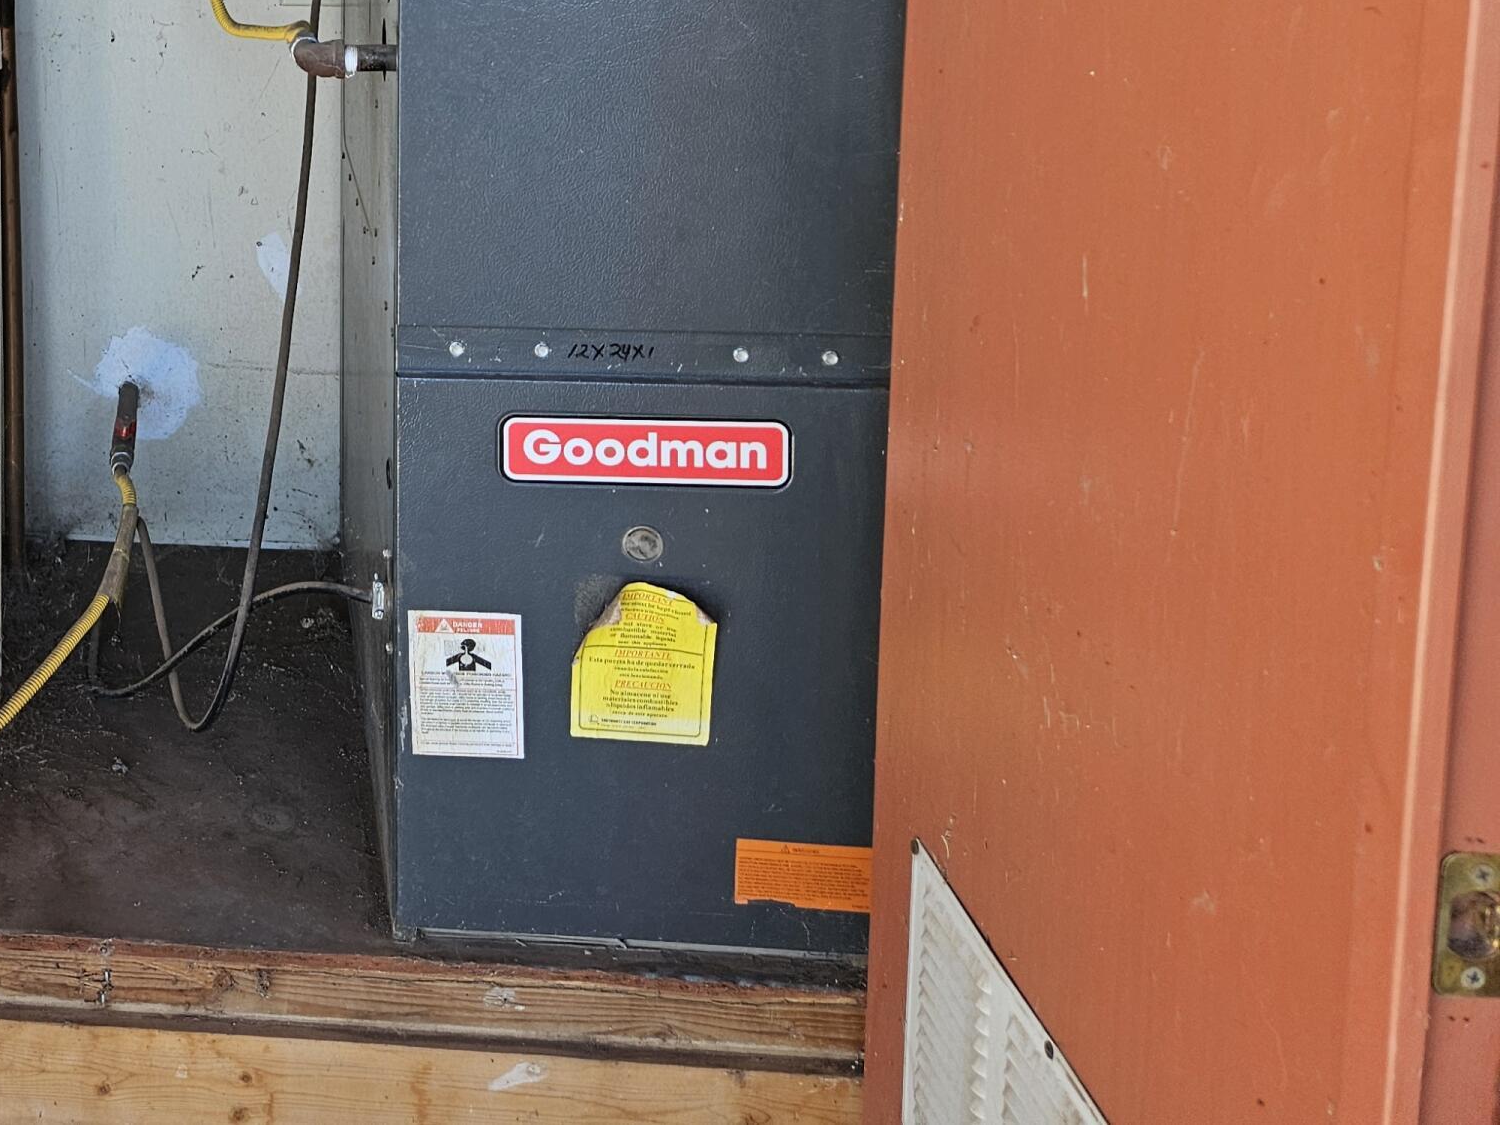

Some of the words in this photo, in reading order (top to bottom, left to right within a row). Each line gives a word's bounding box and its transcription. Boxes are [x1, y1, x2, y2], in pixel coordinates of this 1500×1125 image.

[523, 429, 767, 471] Goodman
[622, 591, 674, 606] IMPORTANT
[625, 613, 665, 625] CAUTION
[614, 649, 672, 660] IMPORTANTE
[614, 679, 672, 691] PRECAUCION
